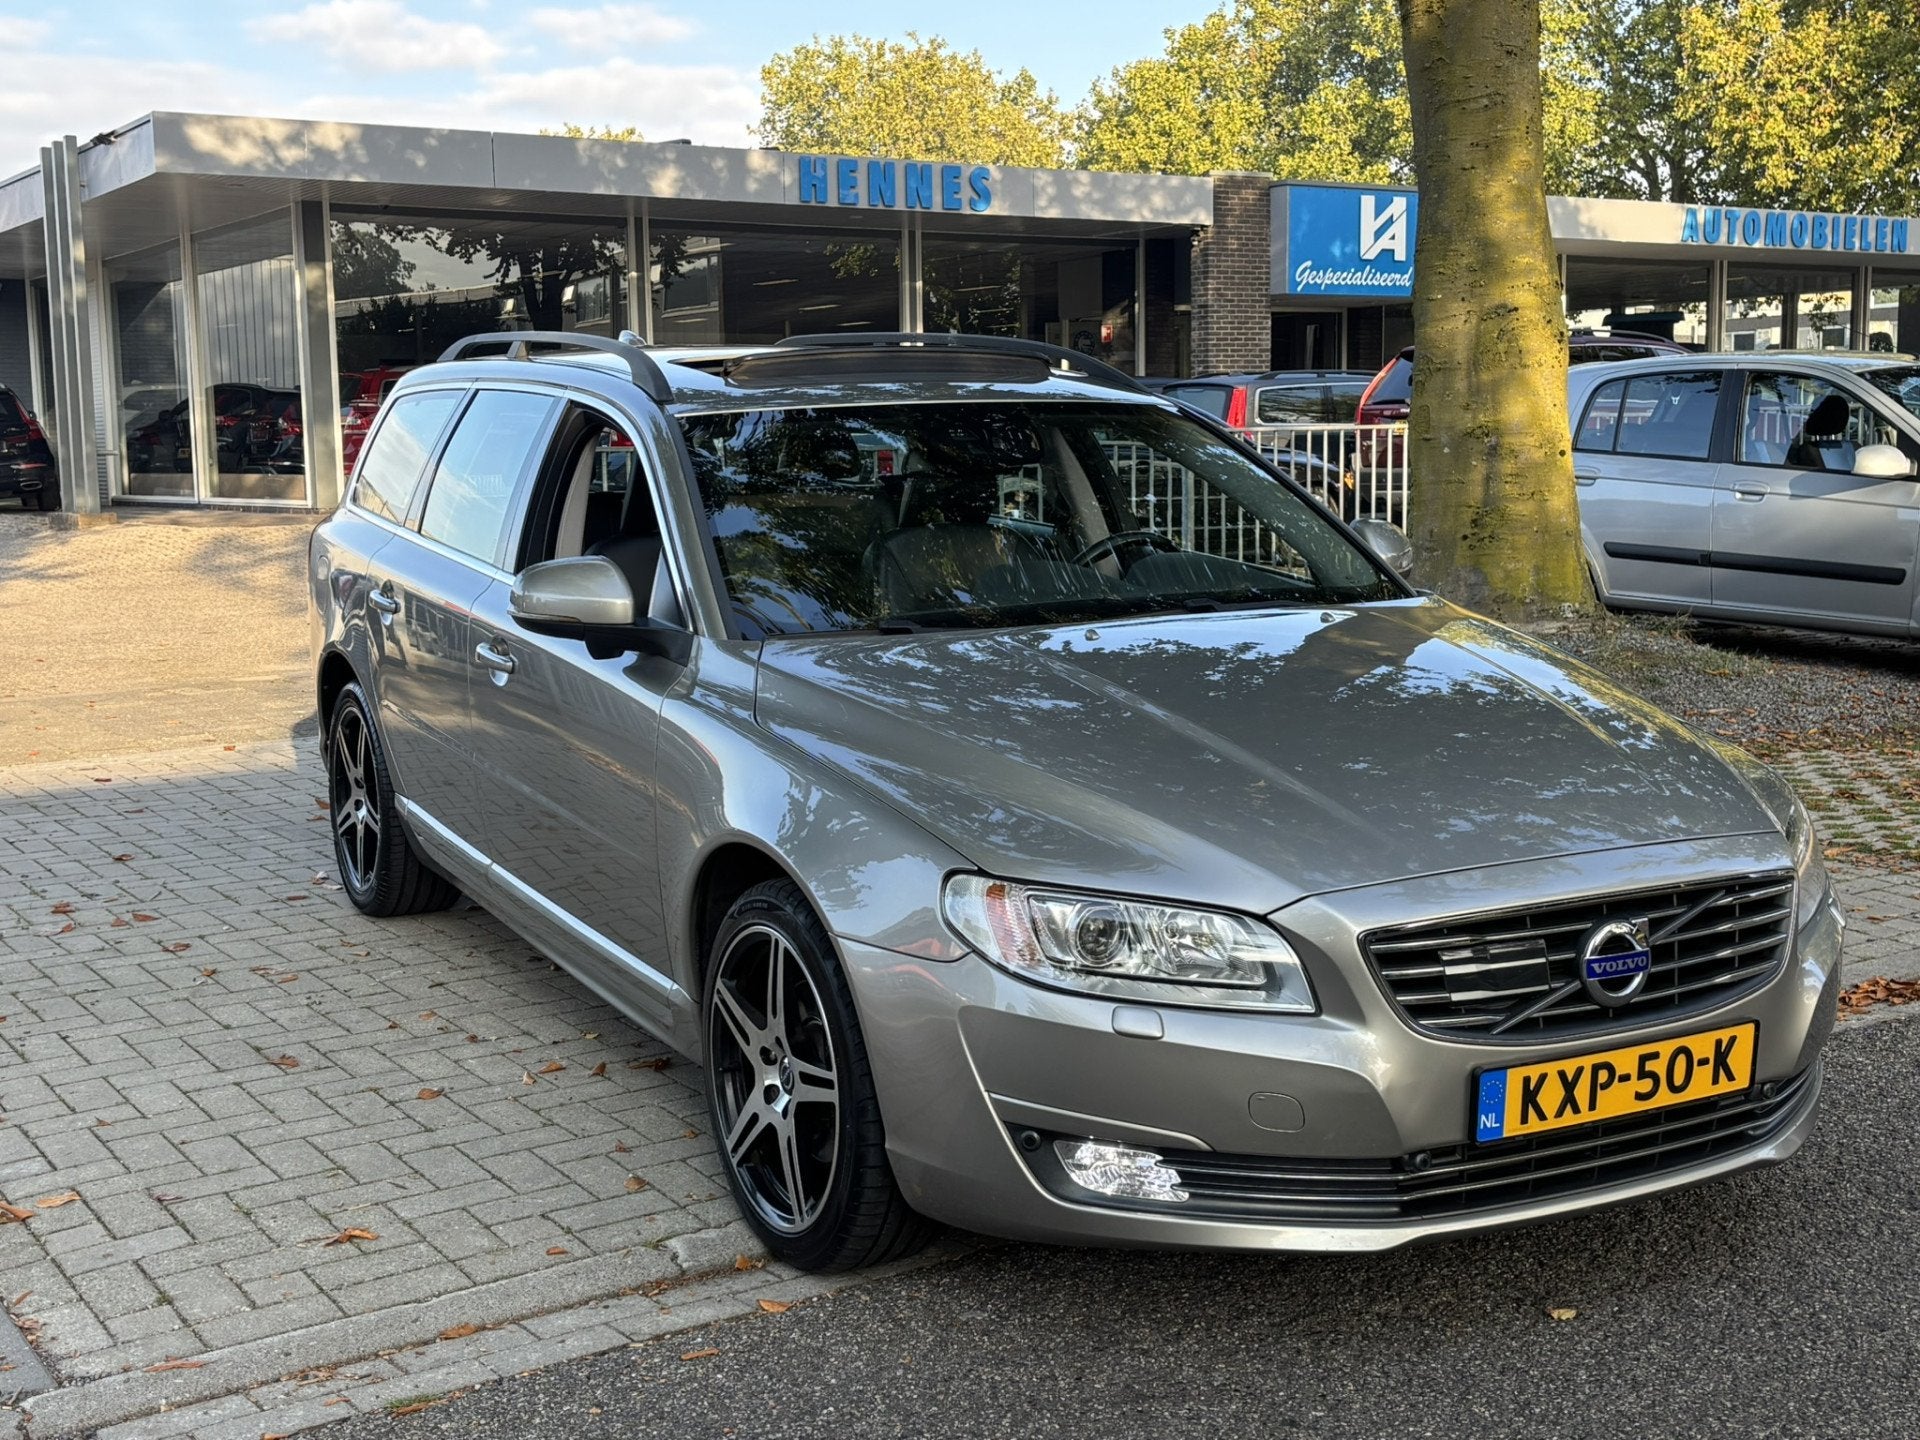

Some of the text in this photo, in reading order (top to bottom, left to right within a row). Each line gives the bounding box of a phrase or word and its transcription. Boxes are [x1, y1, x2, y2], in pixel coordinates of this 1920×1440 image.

[799, 156, 992, 212] HENNES
[1681, 208, 1909, 253] AUTOMOBIELEN
[1295, 260, 1413, 292] Gespecialiseerd
[1590, 956, 1647, 974] VOLVO
[1519, 1034, 1738, 1126] KXP-50-K
[1480, 1113, 1500, 1129] NL
